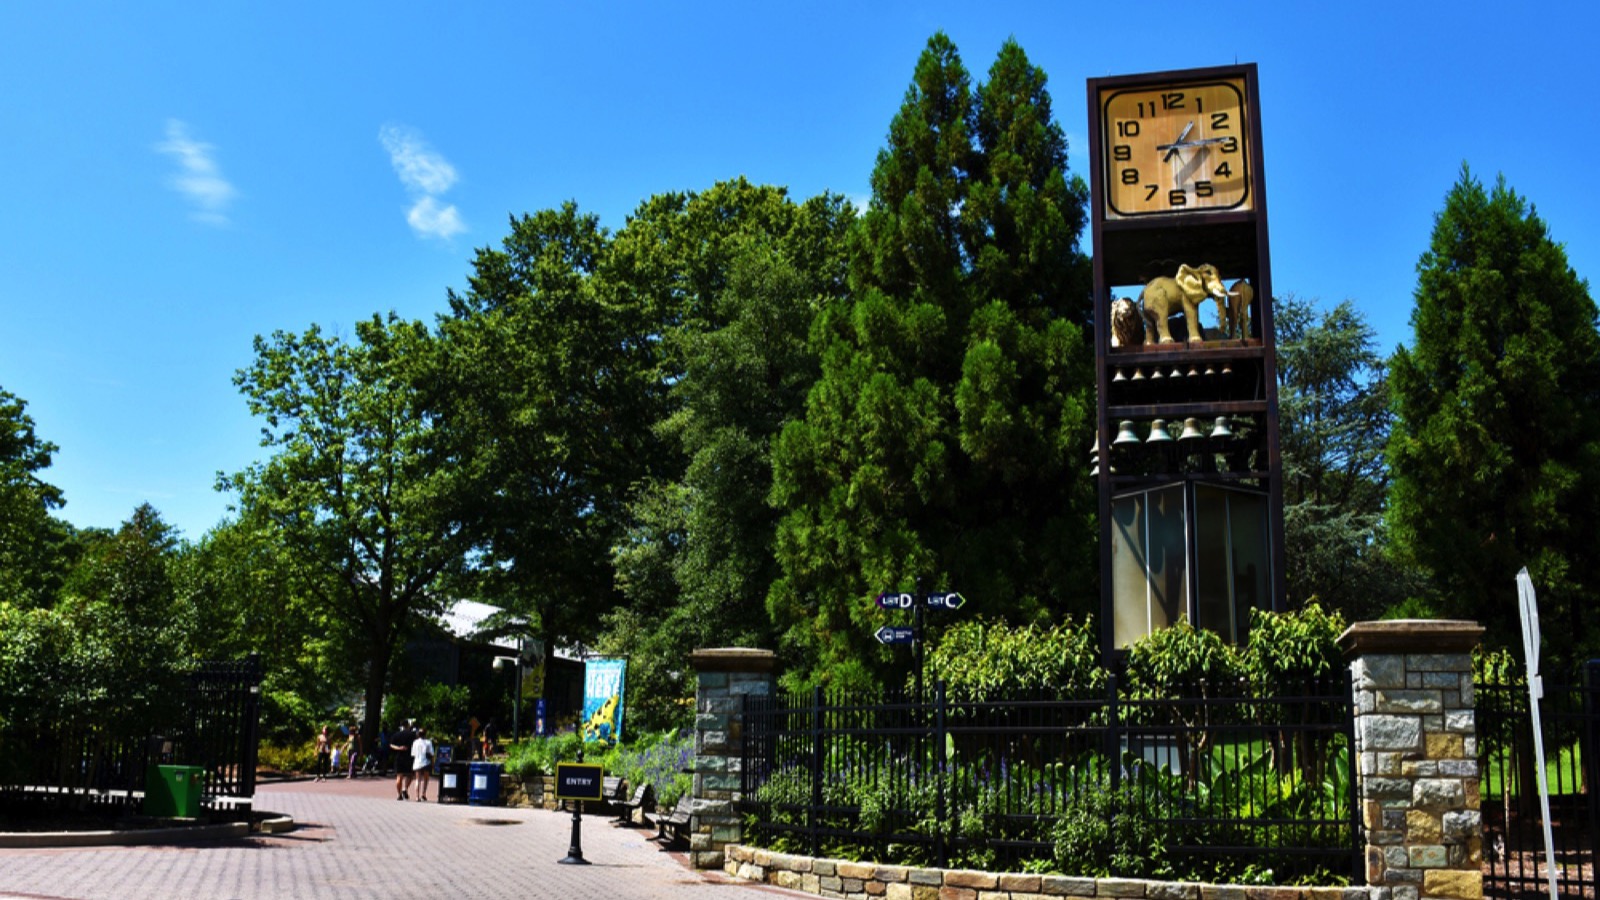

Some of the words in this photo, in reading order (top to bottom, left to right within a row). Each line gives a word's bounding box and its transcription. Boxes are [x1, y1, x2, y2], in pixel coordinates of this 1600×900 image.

[1137, 101, 1156, 118] 11
[1161, 93, 1185, 110] 12
[1195, 97, 1203, 113] 1
[1117, 120, 1140, 137] 10
[1211, 112, 1229, 130] 2
[1114, 145, 1132, 161] 9
[1220, 136, 1238, 154] 3
[1121, 168, 1139, 185] 8
[1214, 162, 1232, 178] 4
[1144, 184, 1159, 201] 7
[1169, 189, 1187, 206] 6
[1195, 181, 1214, 198] 5
[900, 593, 912, 608] D
[945, 593, 956, 608] C
[565, 777, 593, 786] ENTRY
